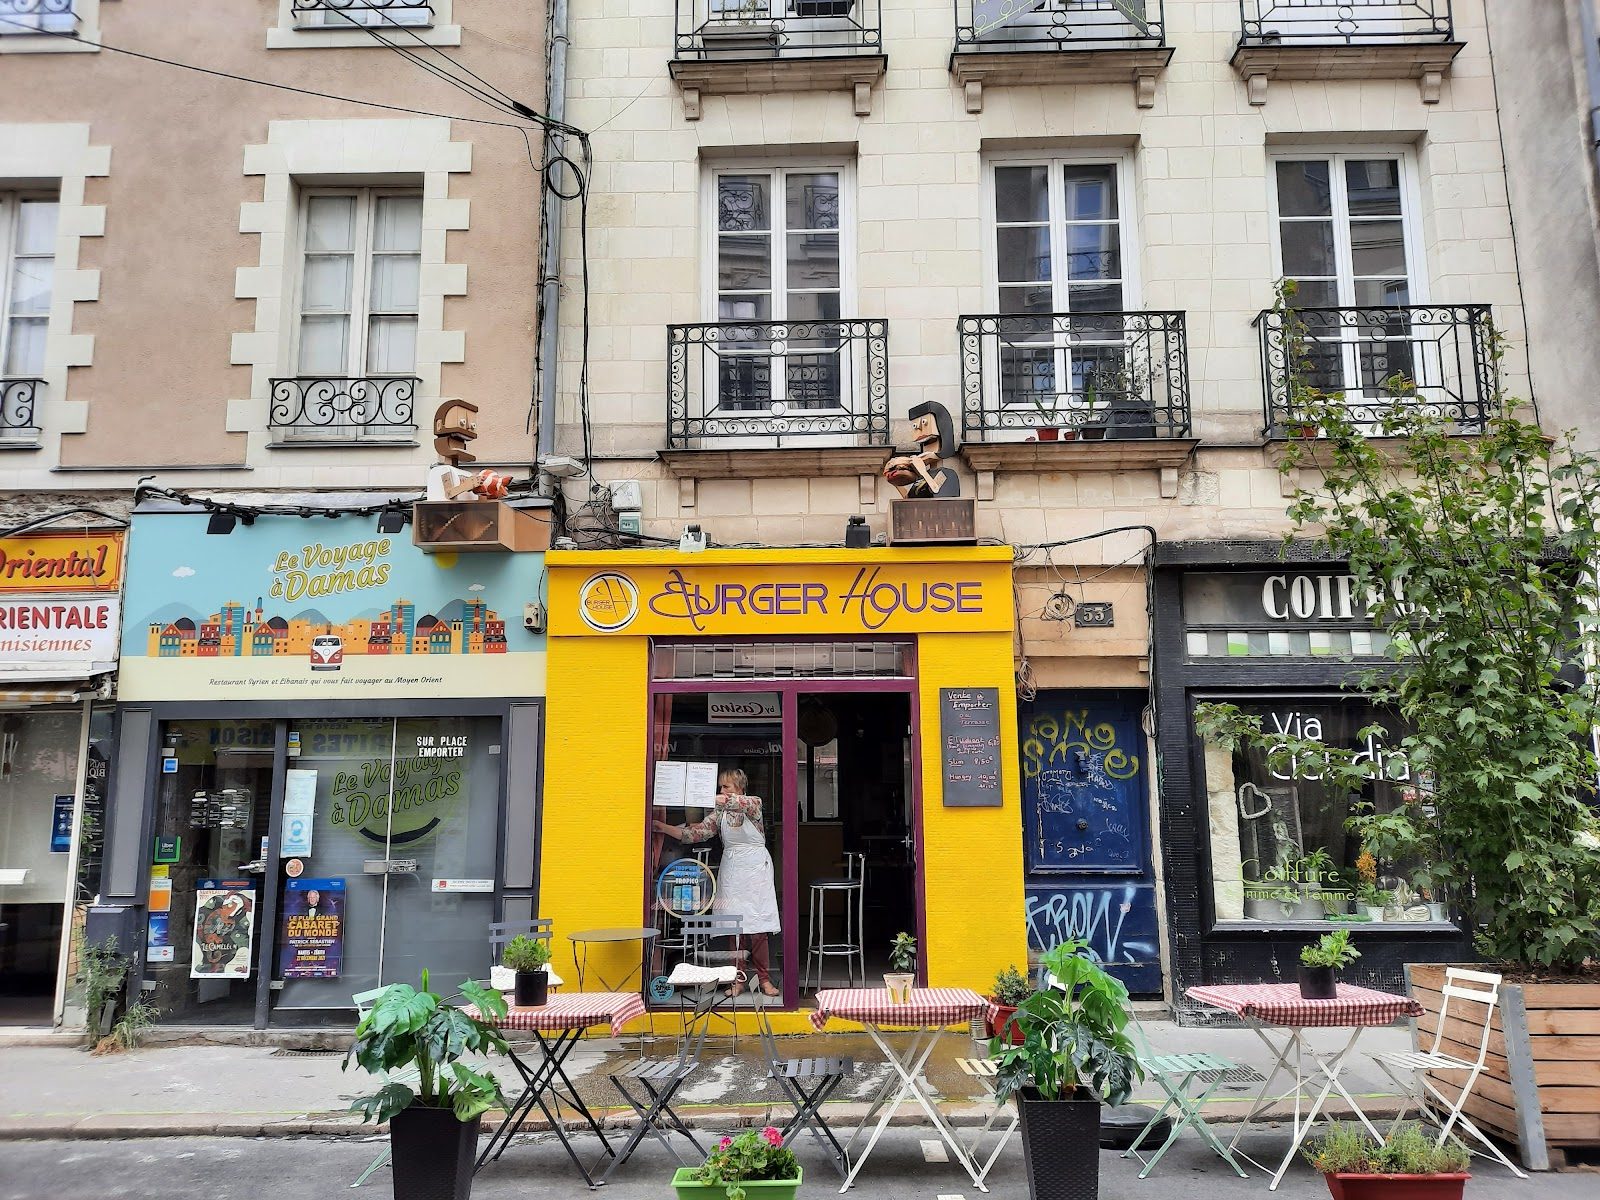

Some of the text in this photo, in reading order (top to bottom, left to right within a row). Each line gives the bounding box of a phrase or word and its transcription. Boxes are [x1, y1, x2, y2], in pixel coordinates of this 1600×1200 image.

[274, 538, 391, 572] Le Voyage
[270, 563, 391, 602] à Damas
[649, 567, 982, 631] BURGER HOUSE
[247, 678, 269, 686] Syrien
[310, 678, 321, 686] qui
[948, 690, 971, 699] Vente
[953, 701, 992, 710] Emporter
[1271, 712, 1322, 740] Via
[416, 736, 467, 746] SUR PLACE
[418, 747, 463, 758] EMPORTER
[1267, 735, 1410, 781] Cldia
[333, 772, 357, 796] Le
[331, 803, 345, 824] à
[346, 771, 461, 827] Damas
[1239, 858, 1340, 885] Coiffure
[1304, 884, 1355, 901] femme
[287, 921, 340, 929] CABARET
[288, 929, 338, 937] DU MONDE
